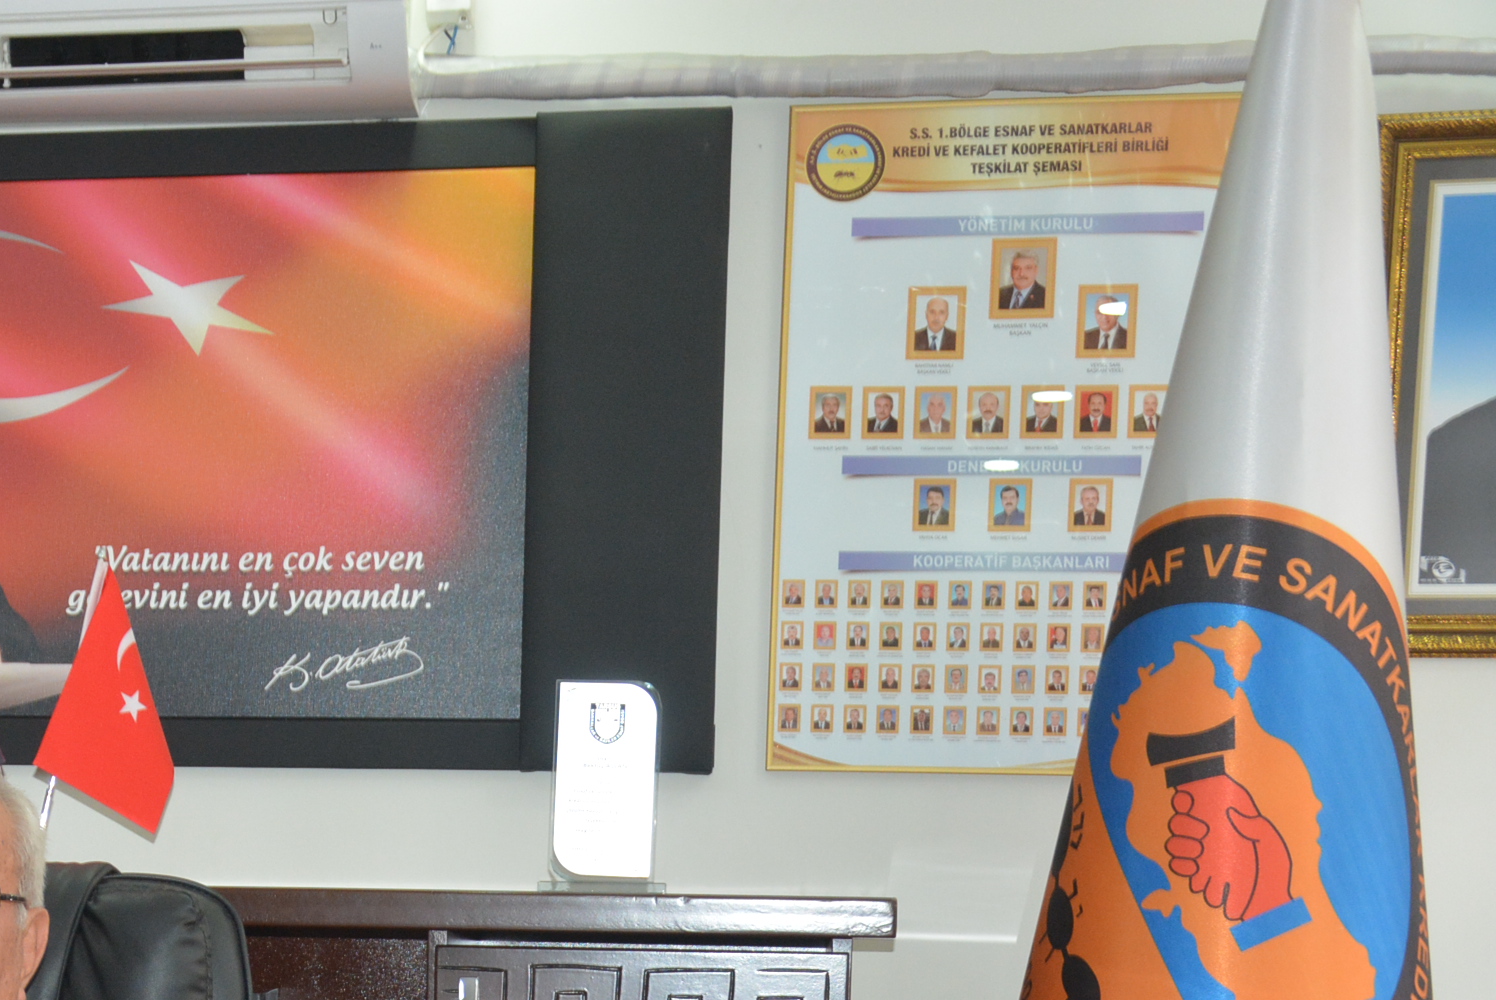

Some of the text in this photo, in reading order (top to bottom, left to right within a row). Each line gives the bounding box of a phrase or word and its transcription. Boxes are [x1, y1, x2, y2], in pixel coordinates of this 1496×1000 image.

[994, 124, 1036, 138] ESNAF
[1039, 123, 1055, 137] VE
[1059, 121, 1153, 136] SANATKARLAR
[892, 142, 931, 158] KREDİ
[933, 144, 950, 157] VE
[953, 142, 1008, 157] KEFALET
[1011, 139, 1118, 155] KOOPERATİFLERİ
[970, 159, 1082, 177] TEŞKİLAT ŞEMASI
[958, 215, 1094, 232] YÖNETİM KURULU
[947, 457, 1083, 473] DENE KURULU
[237, 551, 273, 573] en
[282, 545, 333, 578] çok
[341, 550, 424, 572] seven
[913, 552, 1110, 571] KOOPERATİF BAŞKANLARI
[1202, 543, 1269, 583] VE
[65, 581, 189, 616] gevini
[197, 588, 232, 610] en
[241, 582, 280, 615] iyi
